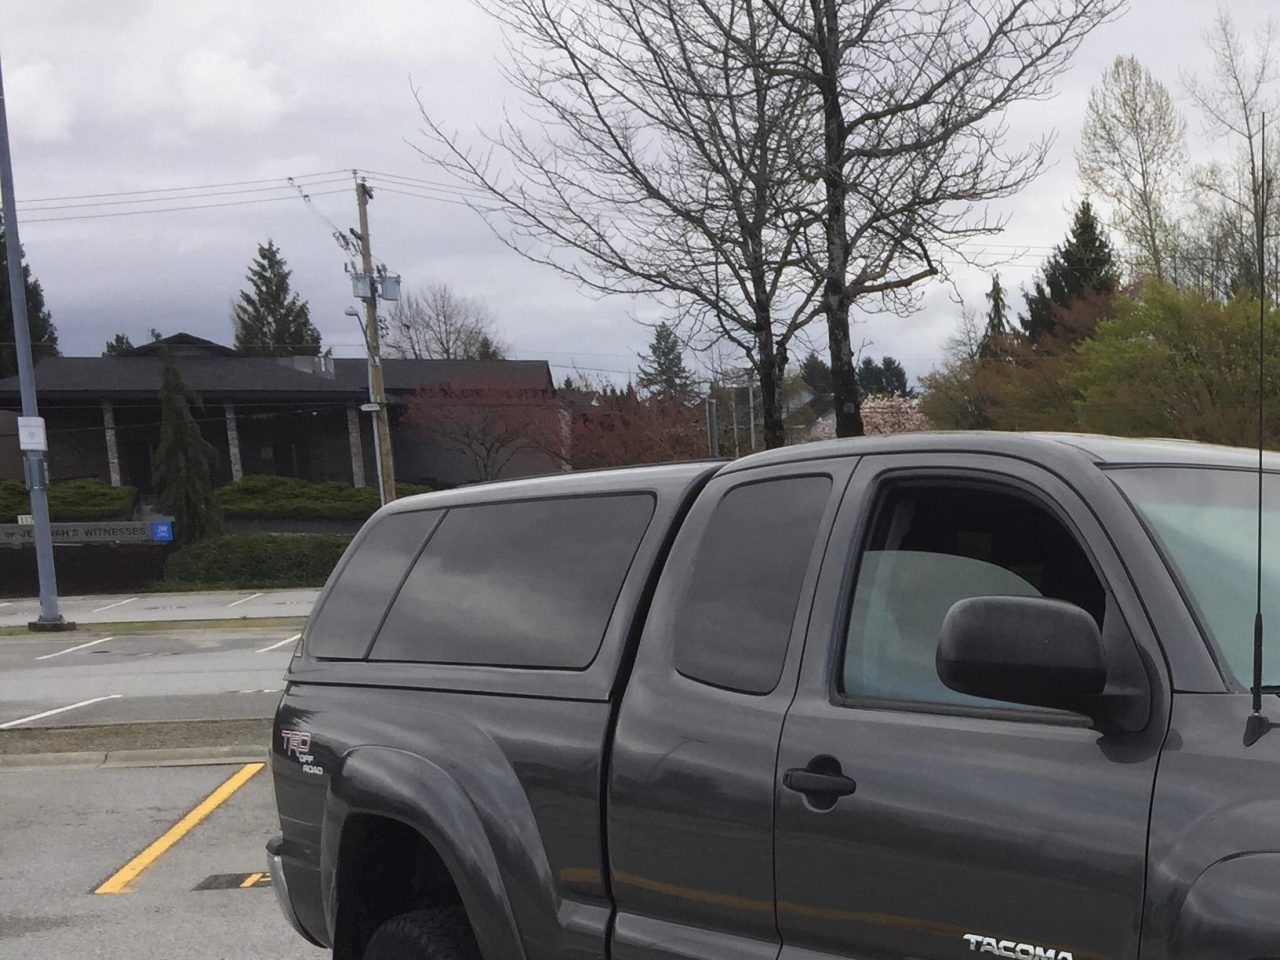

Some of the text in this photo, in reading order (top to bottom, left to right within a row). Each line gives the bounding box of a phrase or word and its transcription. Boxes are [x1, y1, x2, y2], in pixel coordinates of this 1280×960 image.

[20, 528, 80, 538] JEVAH'S
[84, 527, 146, 537] WITNESSES
[281, 730, 311, 756] TRD
[299, 754, 314, 763] OFF
[303, 764, 323, 775] ROAD
